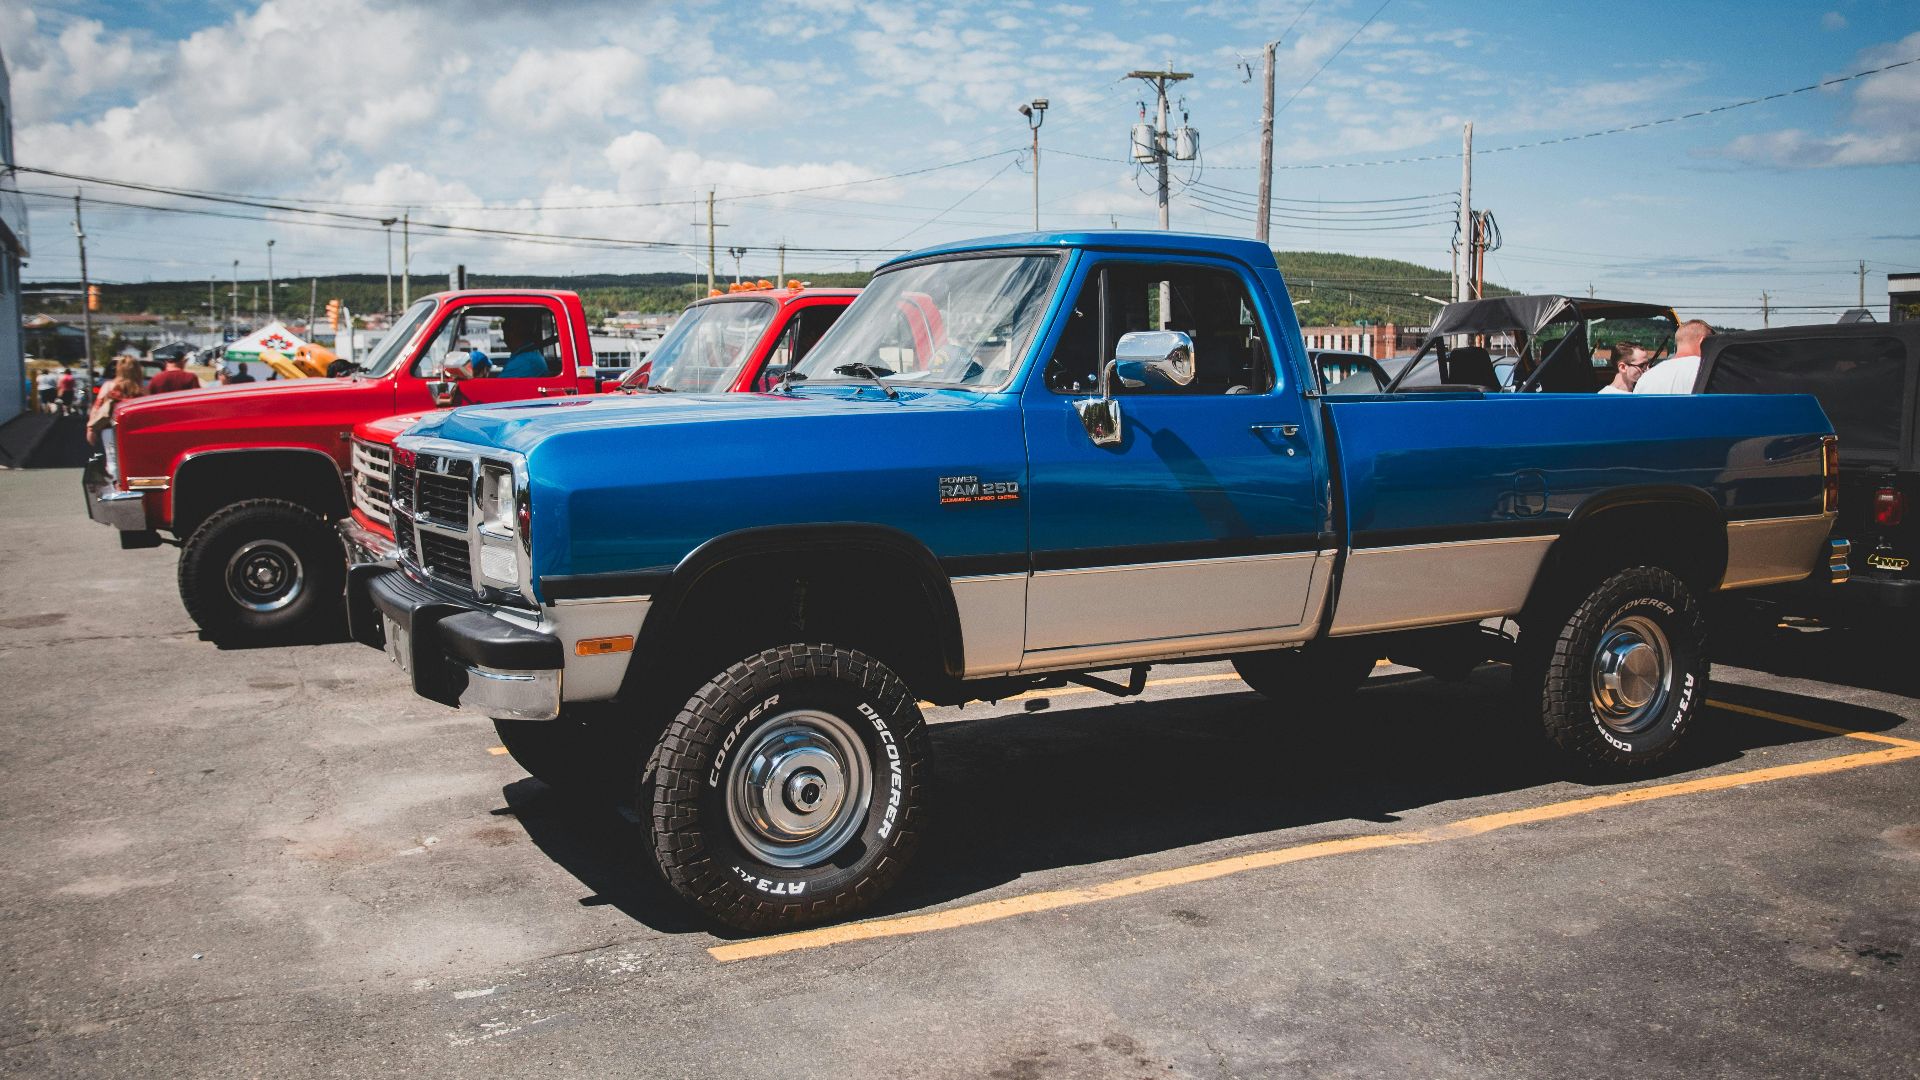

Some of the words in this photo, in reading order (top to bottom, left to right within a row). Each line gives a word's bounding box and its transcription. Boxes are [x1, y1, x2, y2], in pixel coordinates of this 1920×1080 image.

[940, 475, 978, 484] POWER
[941, 484, 979, 497] RAM
[983, 481, 1019, 495] 250
[1679, 673, 1695, 713] AT3
[709, 694, 780, 788] COOPER
[856, 702, 902, 839] DISCOVERER
[731, 865, 760, 883] XLT
[756, 878, 807, 895] AT3
